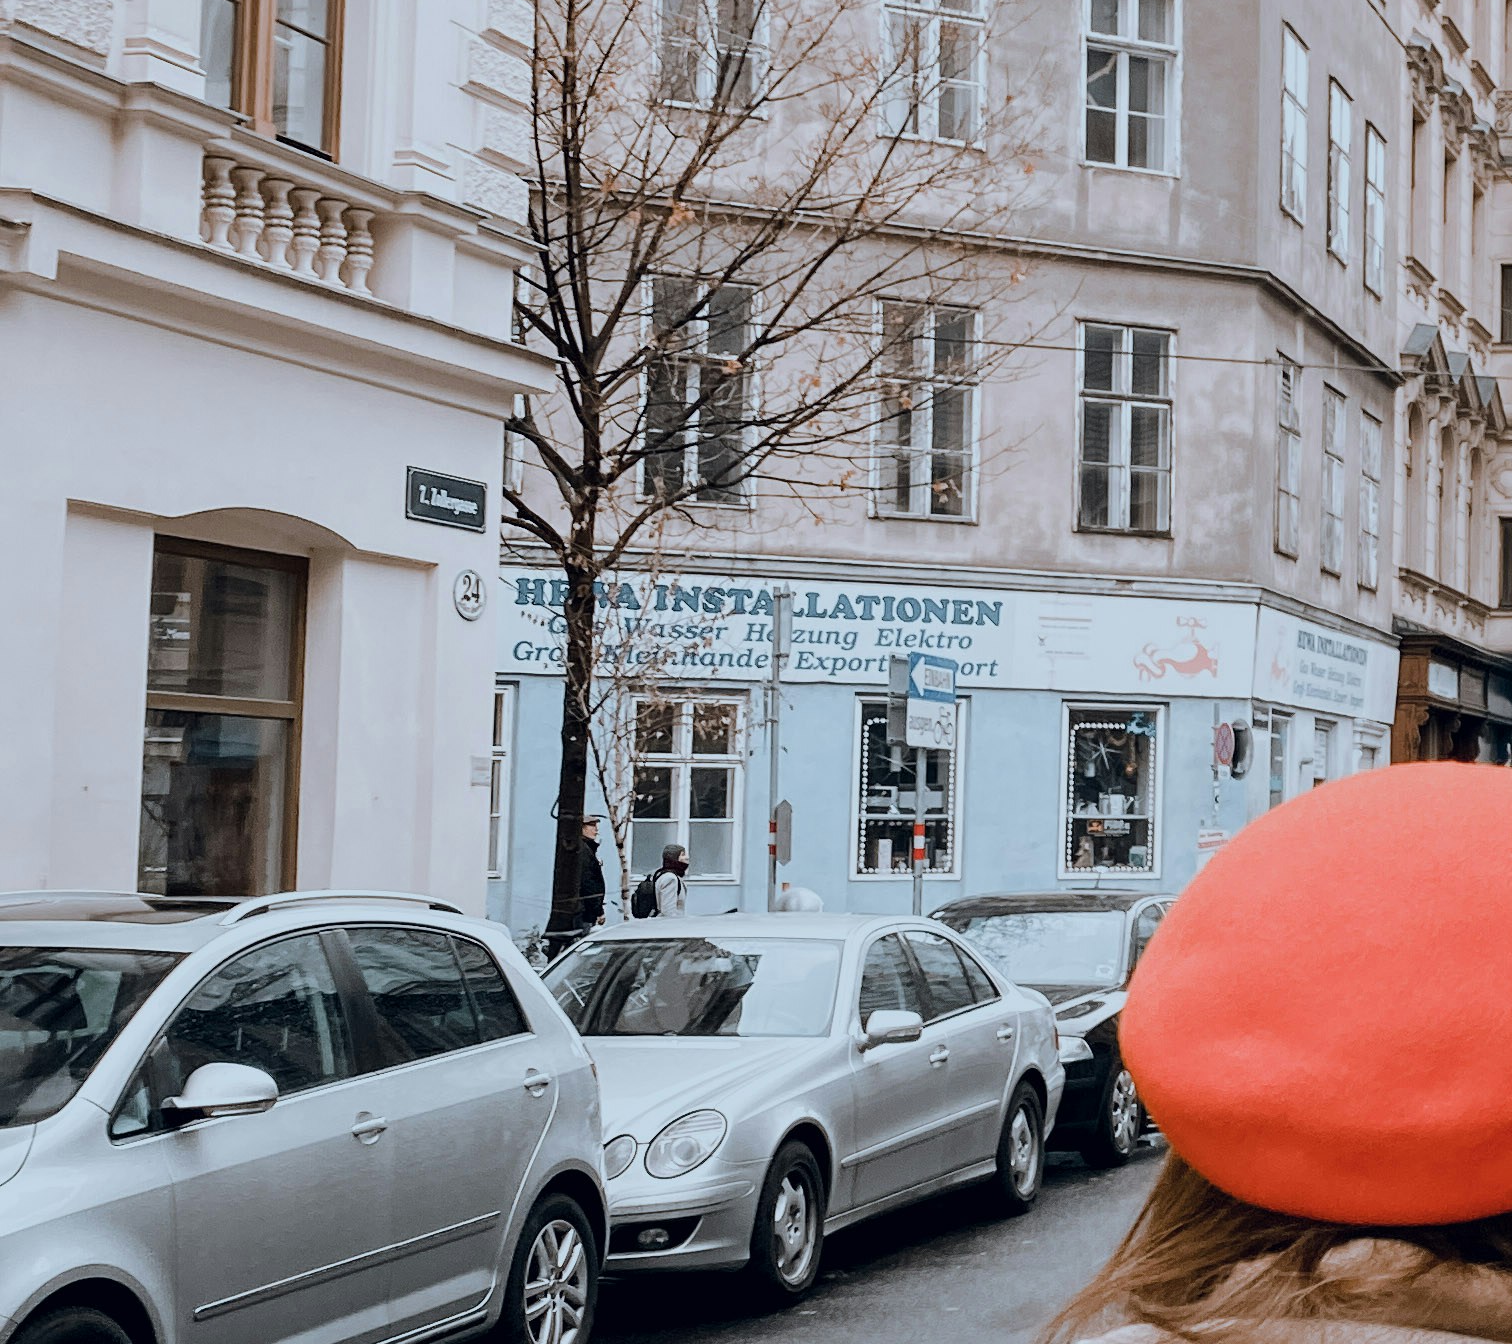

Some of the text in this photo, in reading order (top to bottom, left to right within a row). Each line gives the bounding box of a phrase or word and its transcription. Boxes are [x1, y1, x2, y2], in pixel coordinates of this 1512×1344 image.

[461, 574, 480, 604] 24
[654, 584, 1003, 626] INSTALATIONEN
[548, 615, 973, 651] Gs Wasser Hezung Elektro
[512, 641, 567, 662] Gro
[603, 644, 771, 669] Kleinhande
[795, 651, 888, 676] Export
